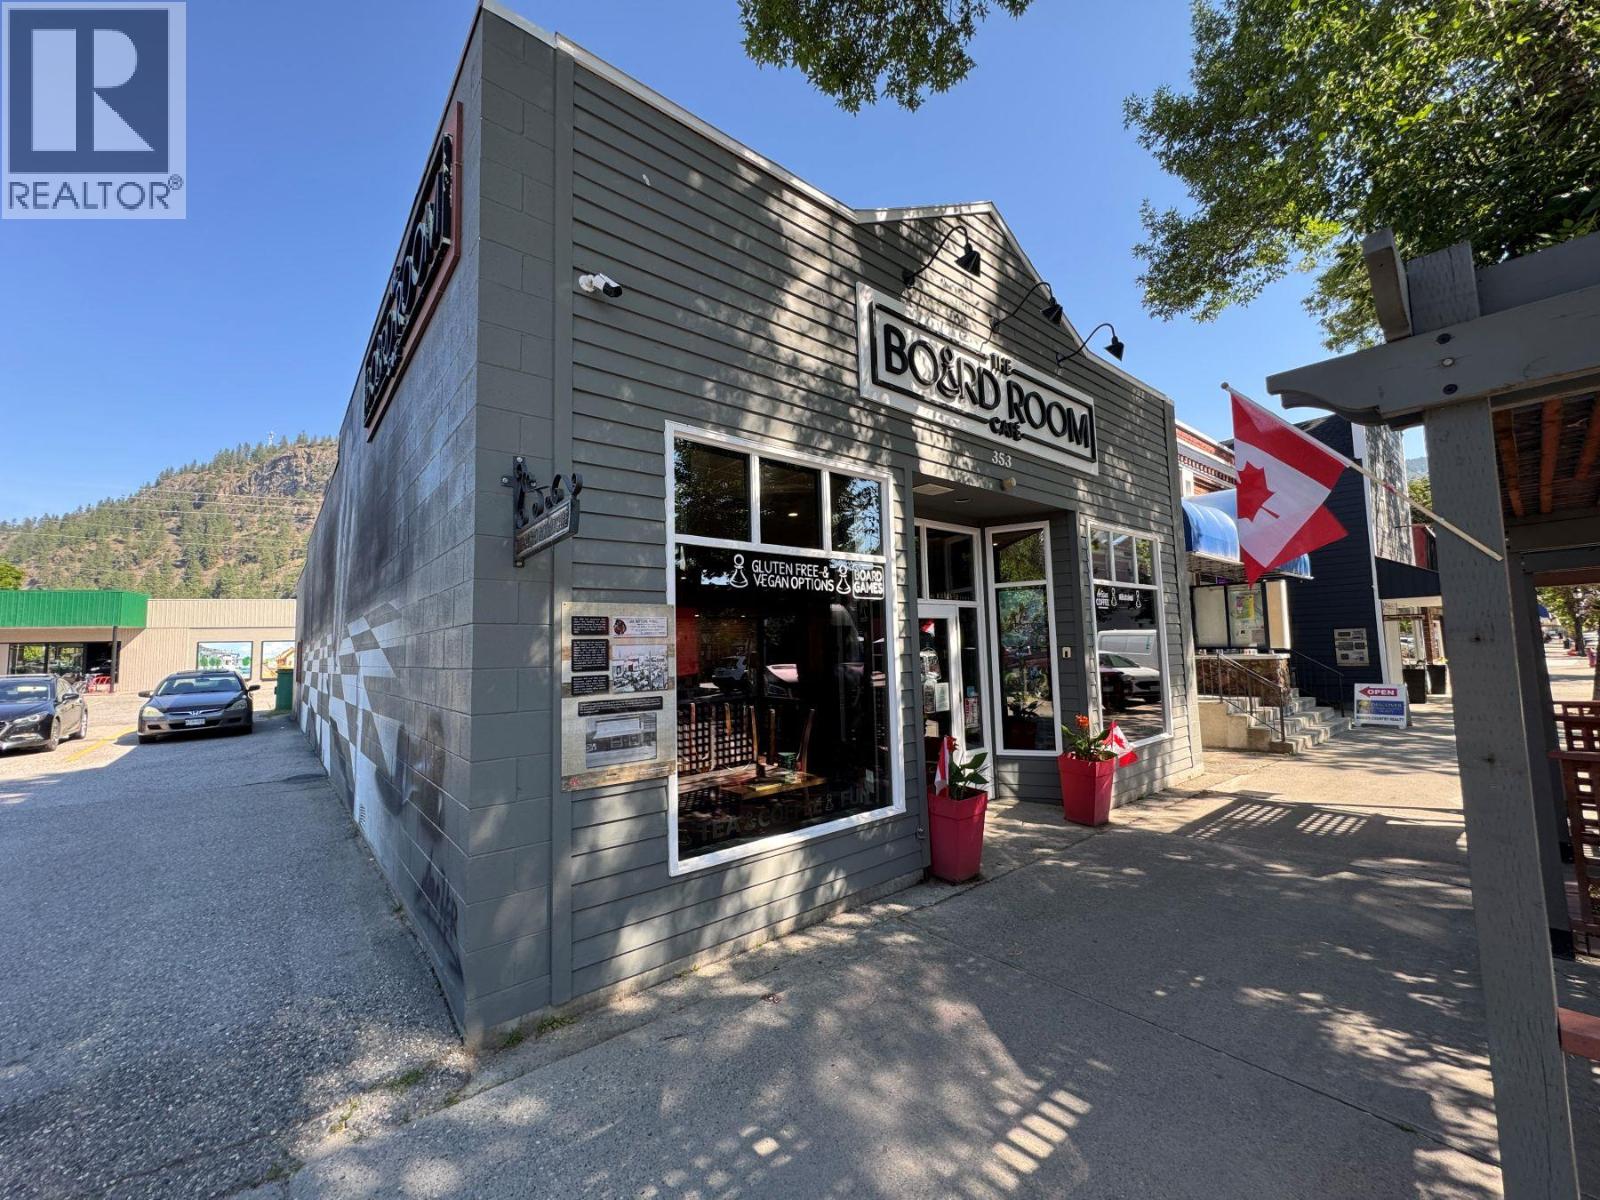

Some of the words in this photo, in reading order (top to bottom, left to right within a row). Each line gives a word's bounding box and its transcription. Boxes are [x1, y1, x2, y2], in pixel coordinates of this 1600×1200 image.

[990, 352, 1013, 377] THE
[884, 323, 1001, 411] BOARD
[1007, 380, 1090, 449] ROOM
[991, 450, 1013, 468] 353
[751, 559, 793, 576] GLUTEN
[795, 563, 819, 577] FREE
[854, 568, 882, 582] BOARD
[753, 573, 790, 589] VEGAN
[790, 576, 834, 592] OPTIONS
[854, 581, 883, 594] GAMES
